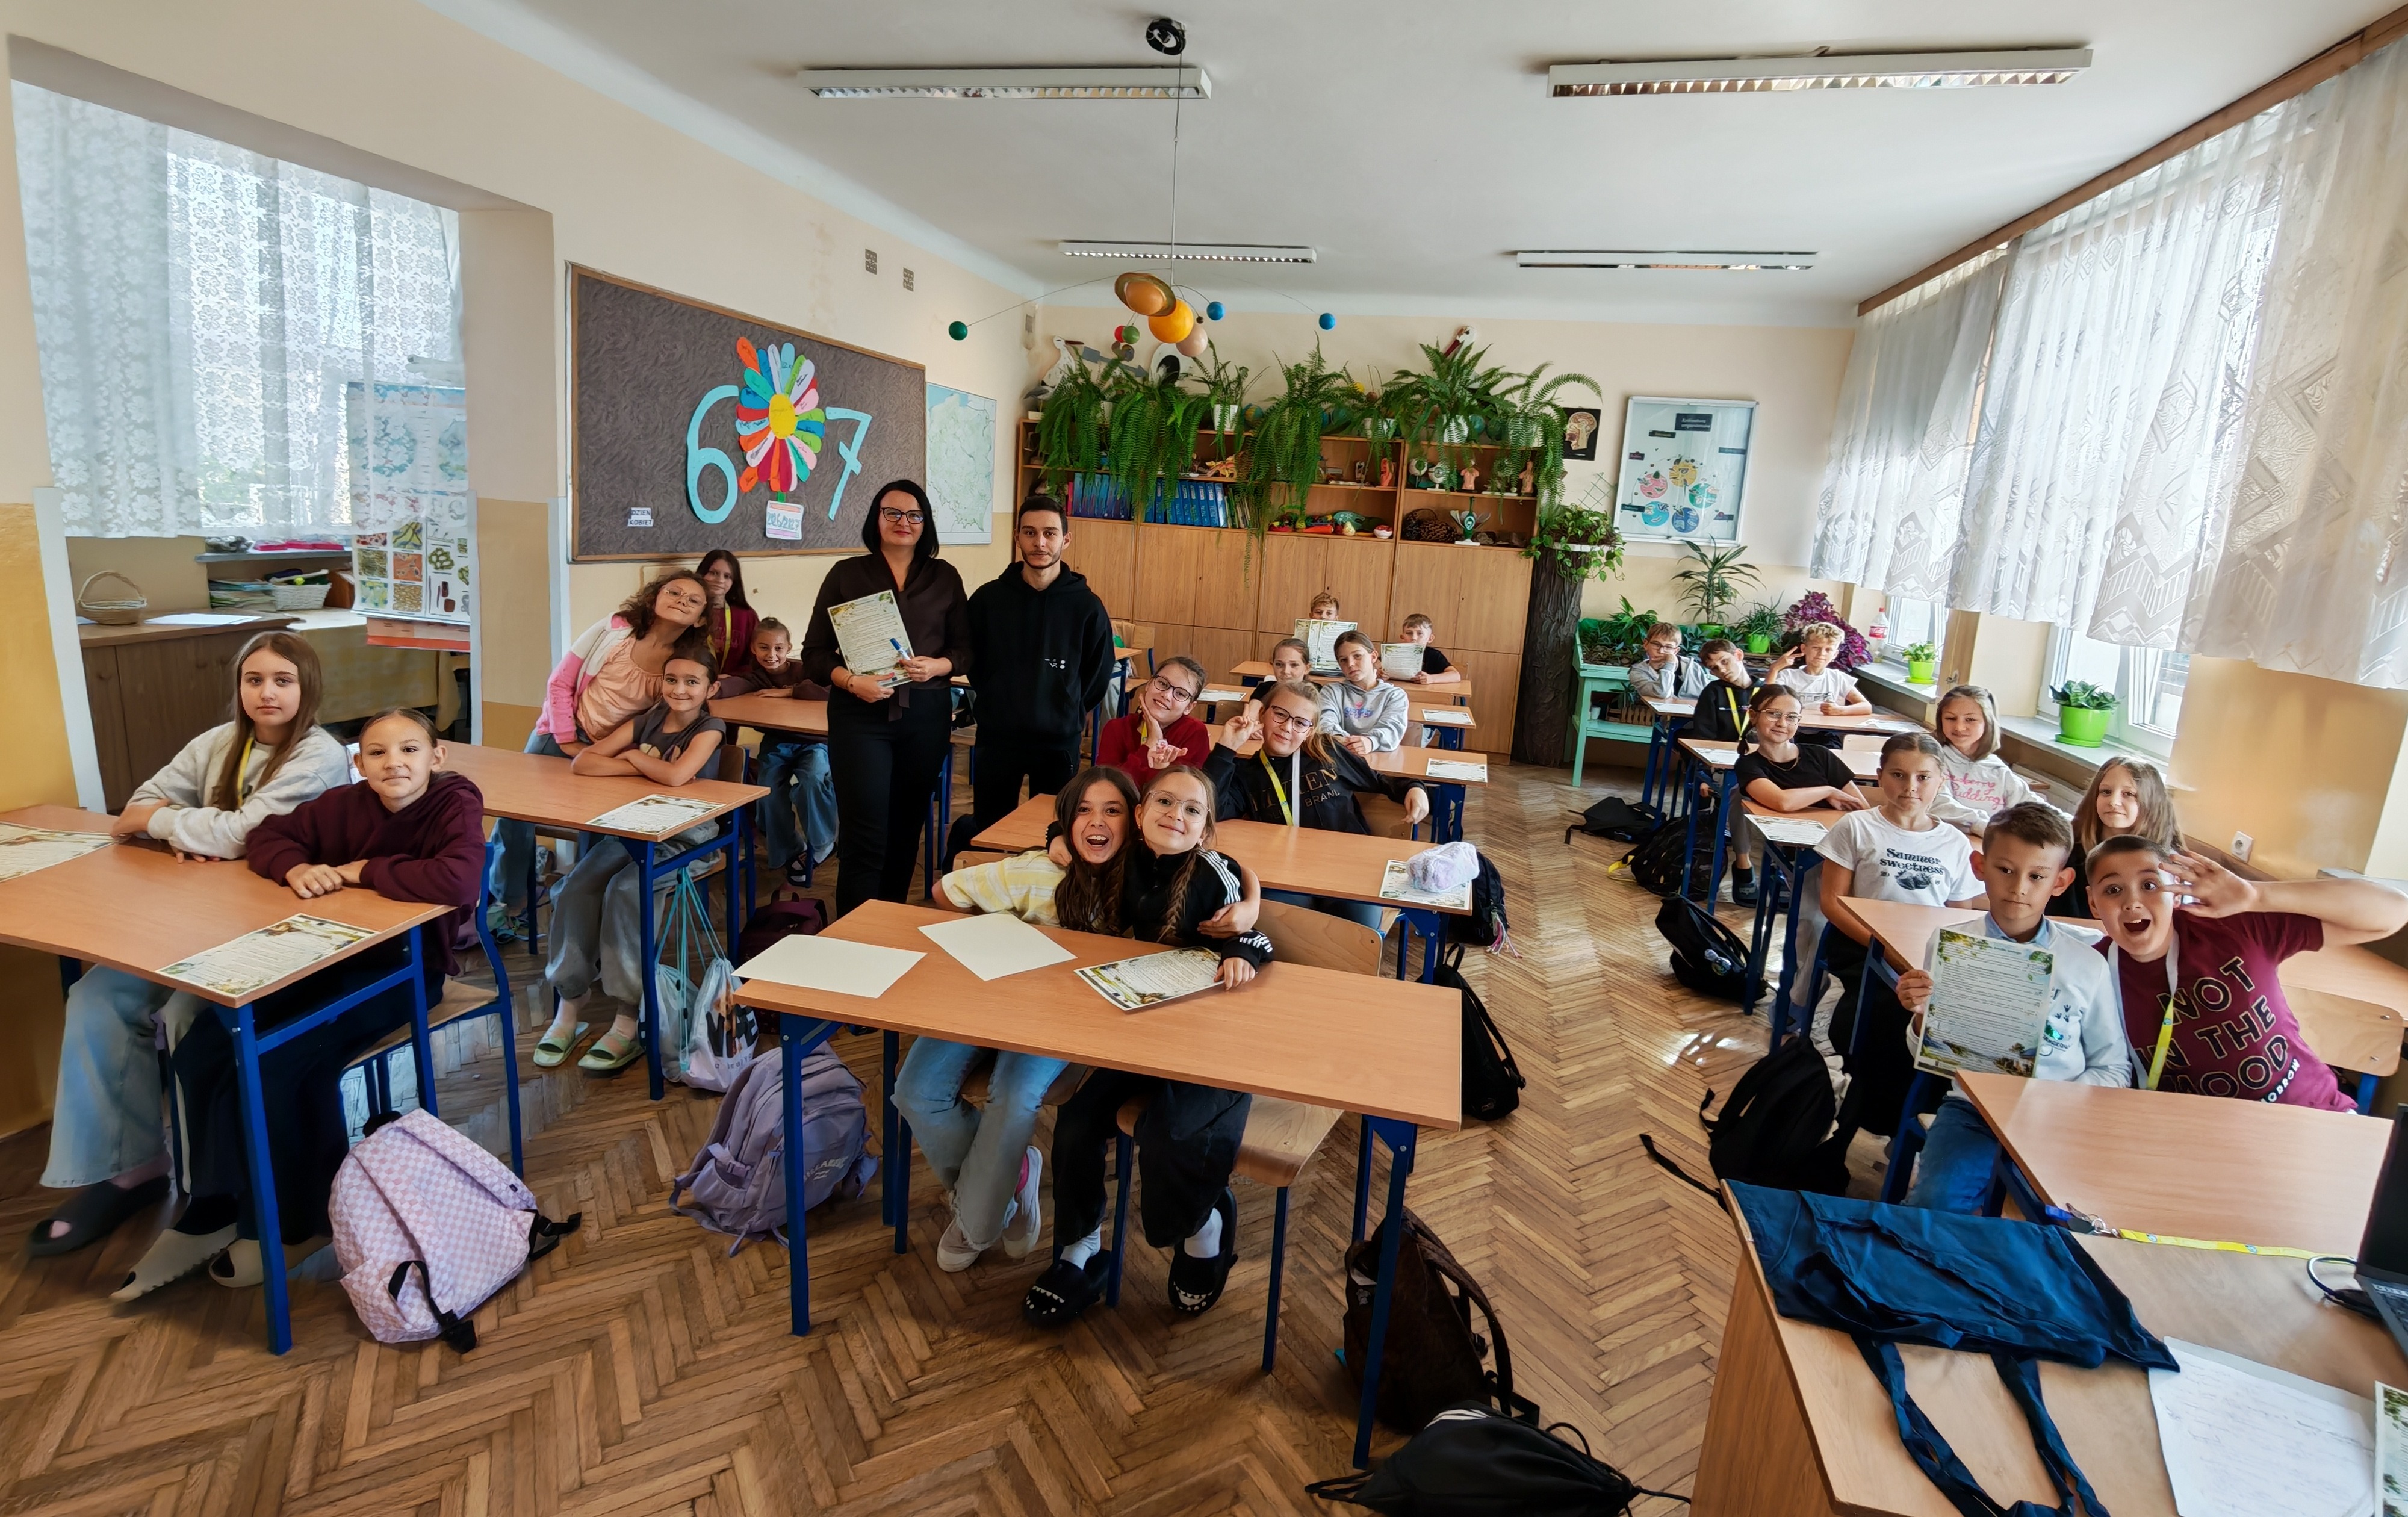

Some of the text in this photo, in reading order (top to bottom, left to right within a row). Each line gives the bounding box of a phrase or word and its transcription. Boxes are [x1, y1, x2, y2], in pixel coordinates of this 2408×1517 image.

[1879, 858, 1944, 875] sweetness
[2156, 956, 2256, 1025] NOT
[2194, 994, 2277, 1059] THE
[2261, 1059, 2301, 1103] ORROW
